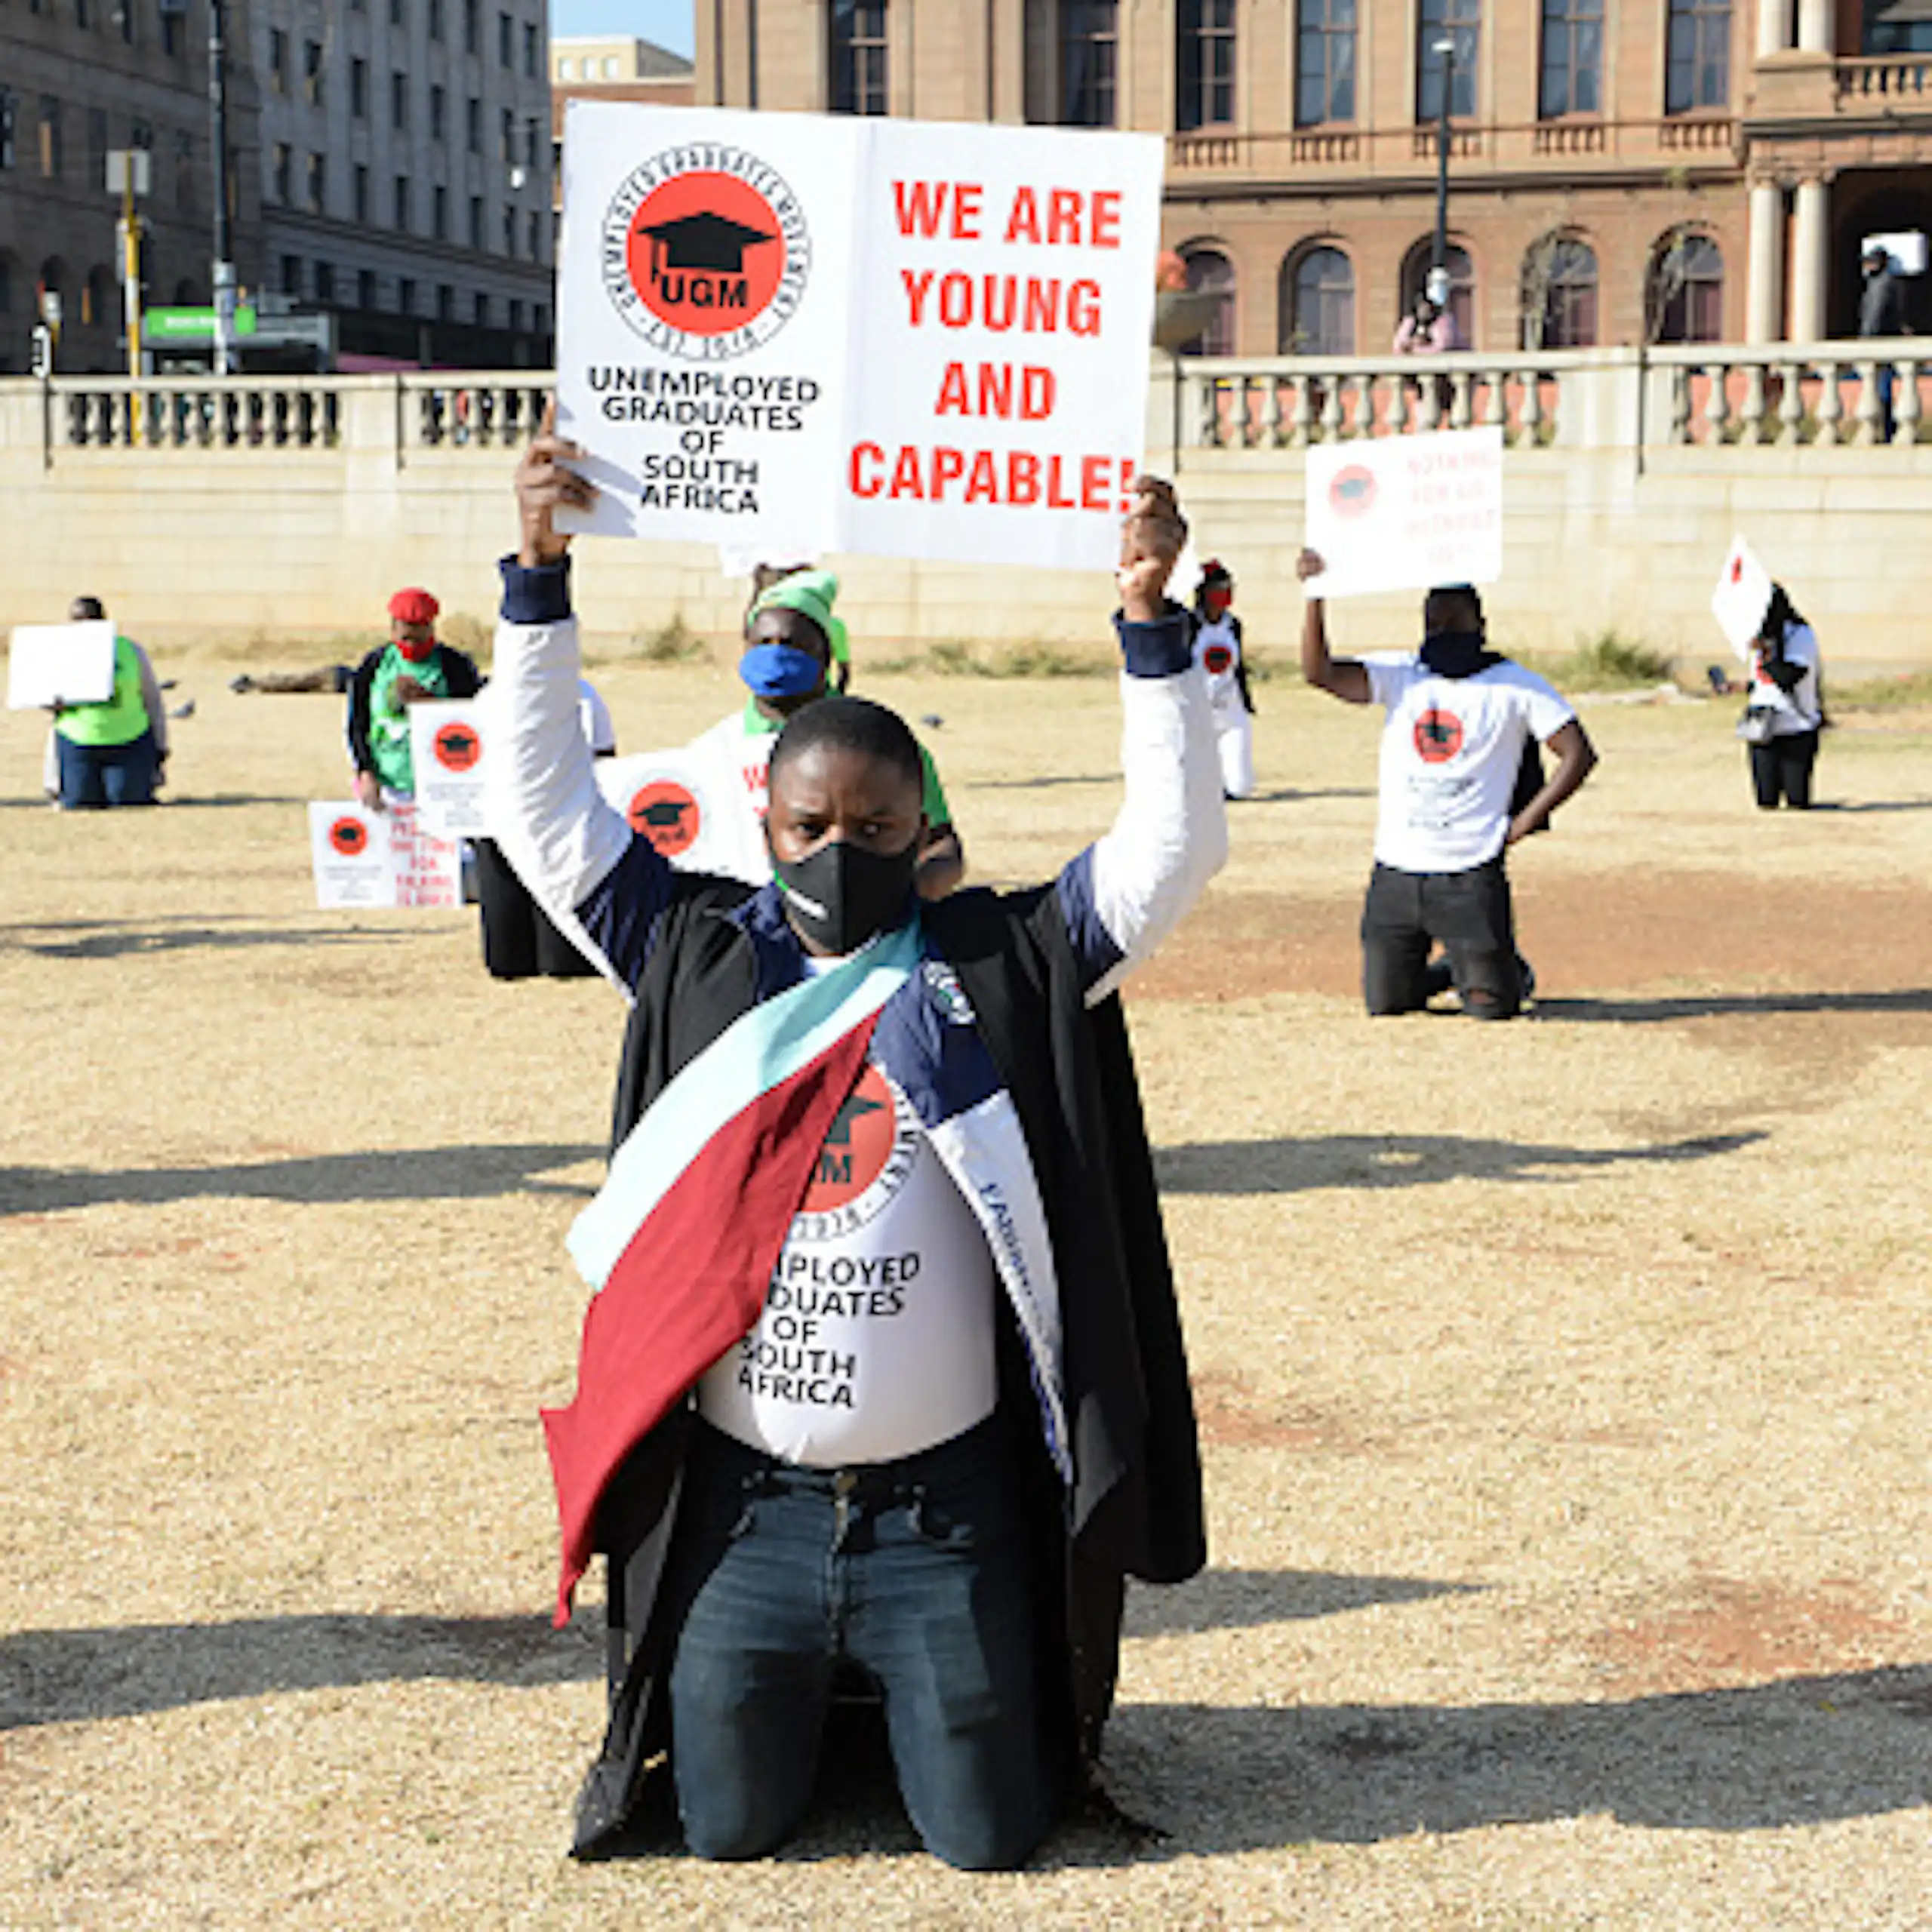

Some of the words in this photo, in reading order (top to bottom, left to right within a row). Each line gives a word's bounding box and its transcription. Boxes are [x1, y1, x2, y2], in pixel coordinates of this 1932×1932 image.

[891, 180, 983, 240] WE
[1002, 186, 1123, 249] ARE
[660, 273, 748, 308] UGM
[900, 269, 1102, 338] YOUNG
[587, 366, 820, 402] UNEMPLOYED
[934, 361, 1057, 421] AND
[601, 397, 803, 430] GRADUATES
[680, 431, 724, 455] OF
[644, 454, 758, 484] SOUTH
[848, 440, 1136, 514] CAPABLE!
[641, 485, 758, 514] AFRICA
[777, 1251, 921, 1285] PLOYED
[767, 1283, 906, 1318] DUATES
[773, 1316, 819, 1345] OF
[739, 1336, 856, 1379] SOUTH
[739, 1365, 857, 1409] AFRICA
